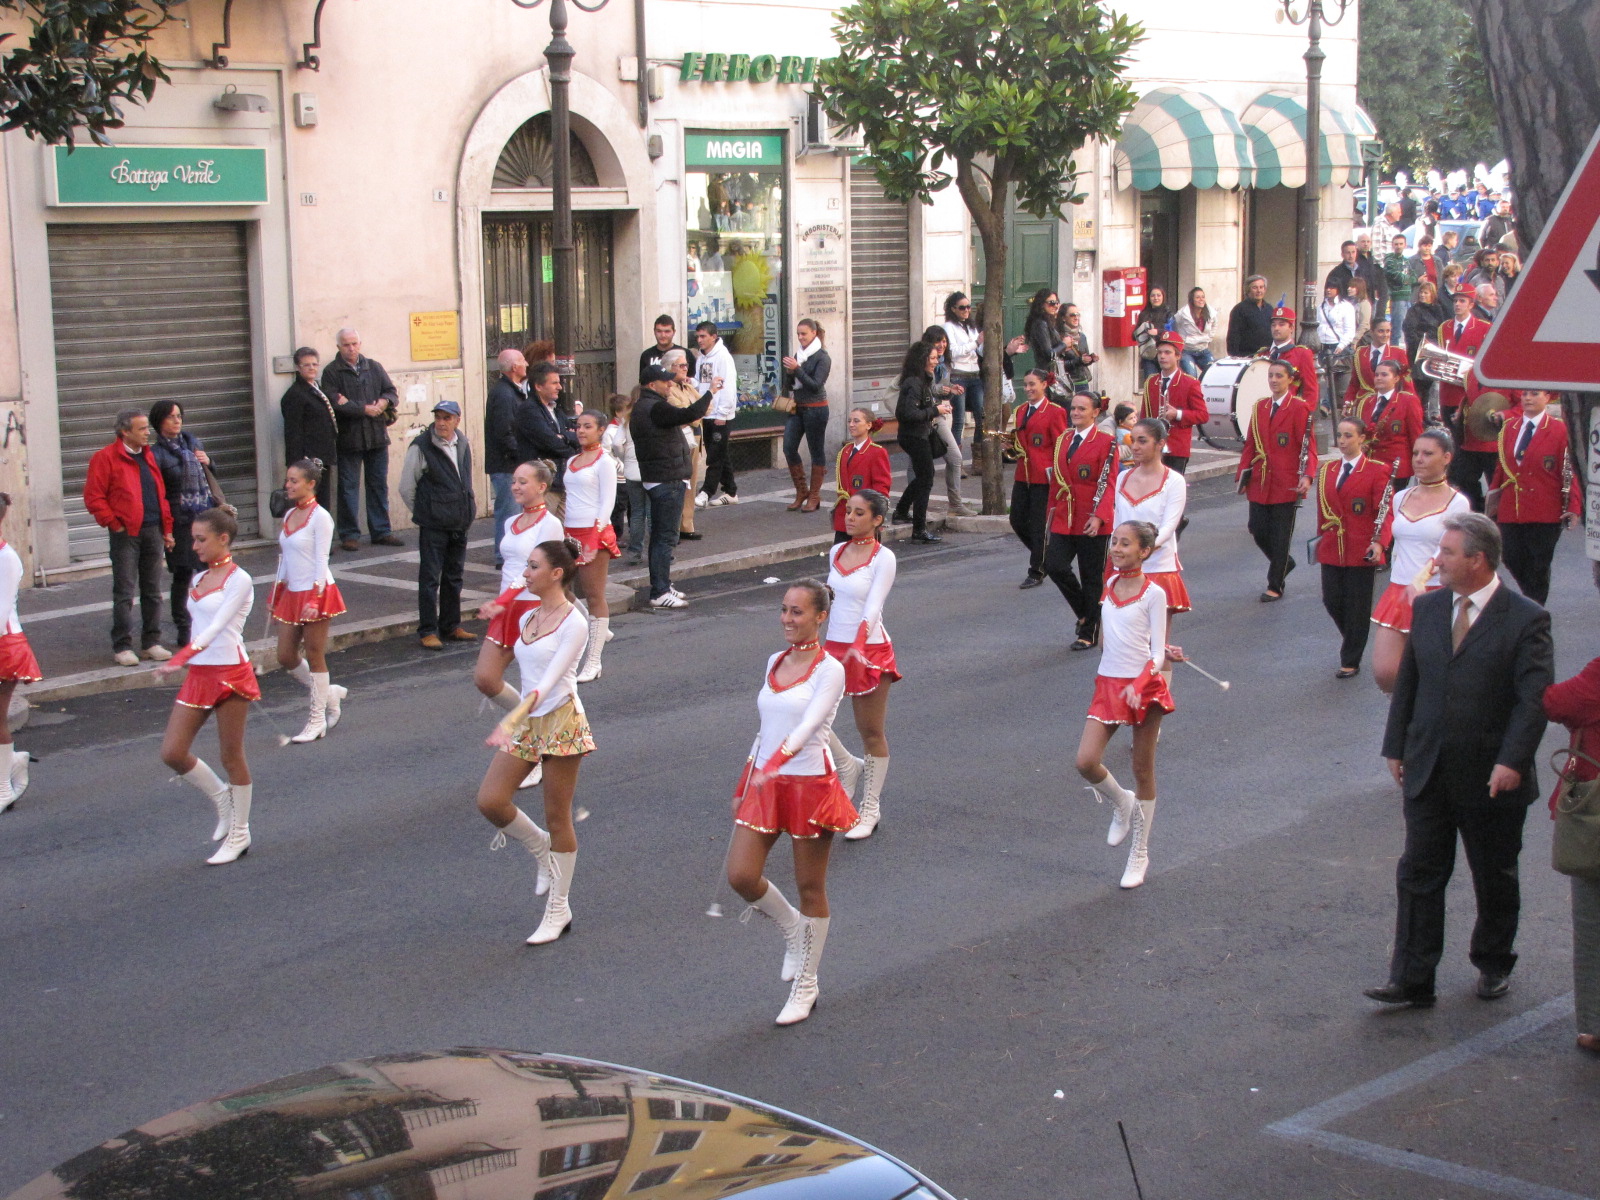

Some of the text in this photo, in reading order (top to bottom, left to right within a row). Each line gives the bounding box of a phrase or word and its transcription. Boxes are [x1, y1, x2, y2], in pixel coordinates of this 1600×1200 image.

[706, 141, 763, 159] MAGIA
[110, 159, 221, 191] Bottega Verde
[304, 194, 314, 204] 10
[438, 191, 443, 200] 8
[802, 224, 842, 241] ERBORISTERIA
[1587, 527, 1600, 539] Sicu
